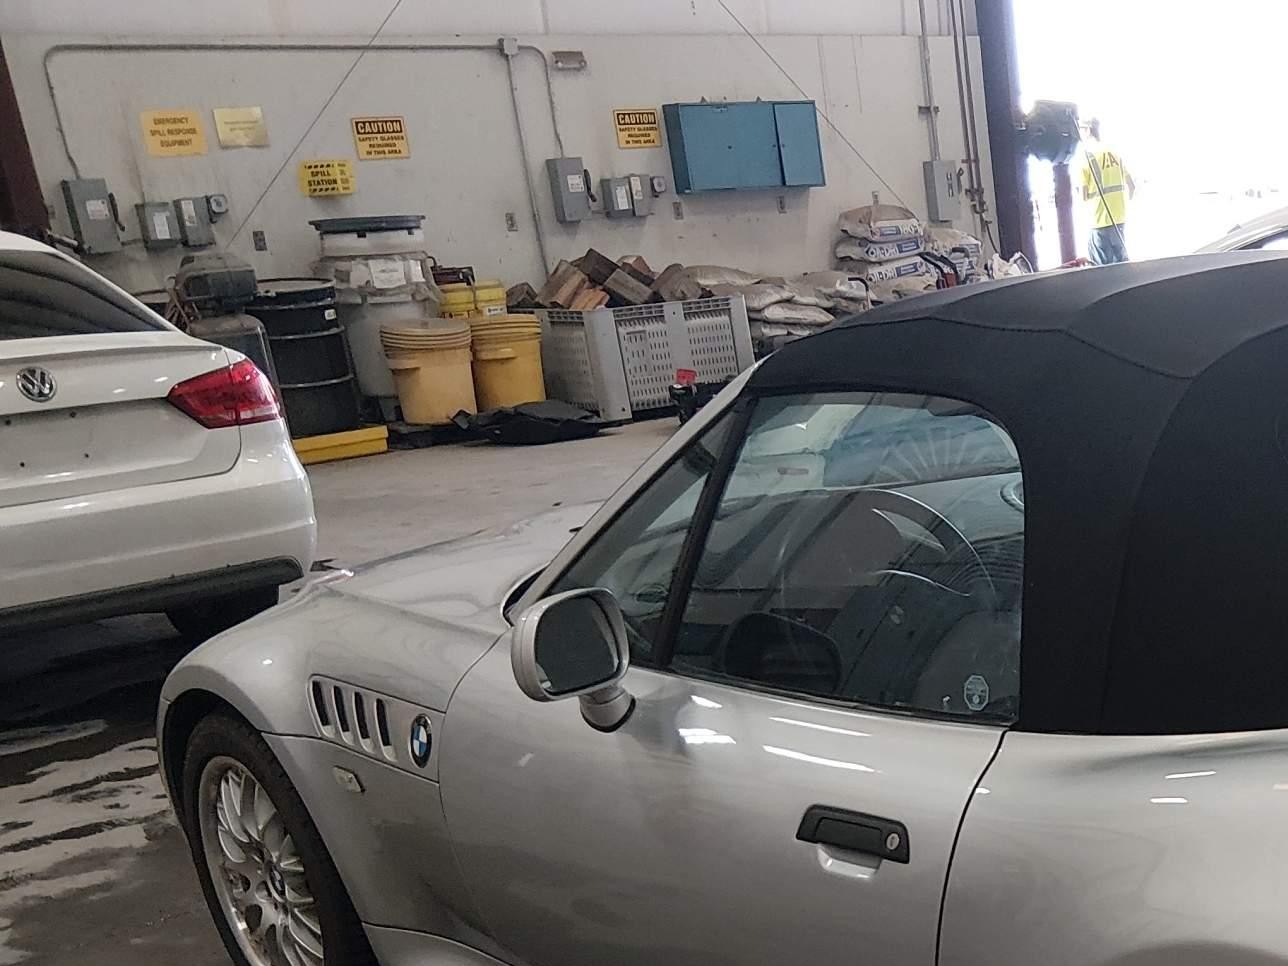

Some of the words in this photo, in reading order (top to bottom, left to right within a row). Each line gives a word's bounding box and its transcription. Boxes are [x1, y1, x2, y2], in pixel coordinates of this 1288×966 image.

[153, 117, 189, 126] EMERGENCY
[618, 113, 655, 124] CAUTION
[357, 120, 402, 133] CAUTION
[150, 129, 166, 137] SPILL
[310, 170, 332, 178] SPILL
[307, 178, 338, 187] STATION
